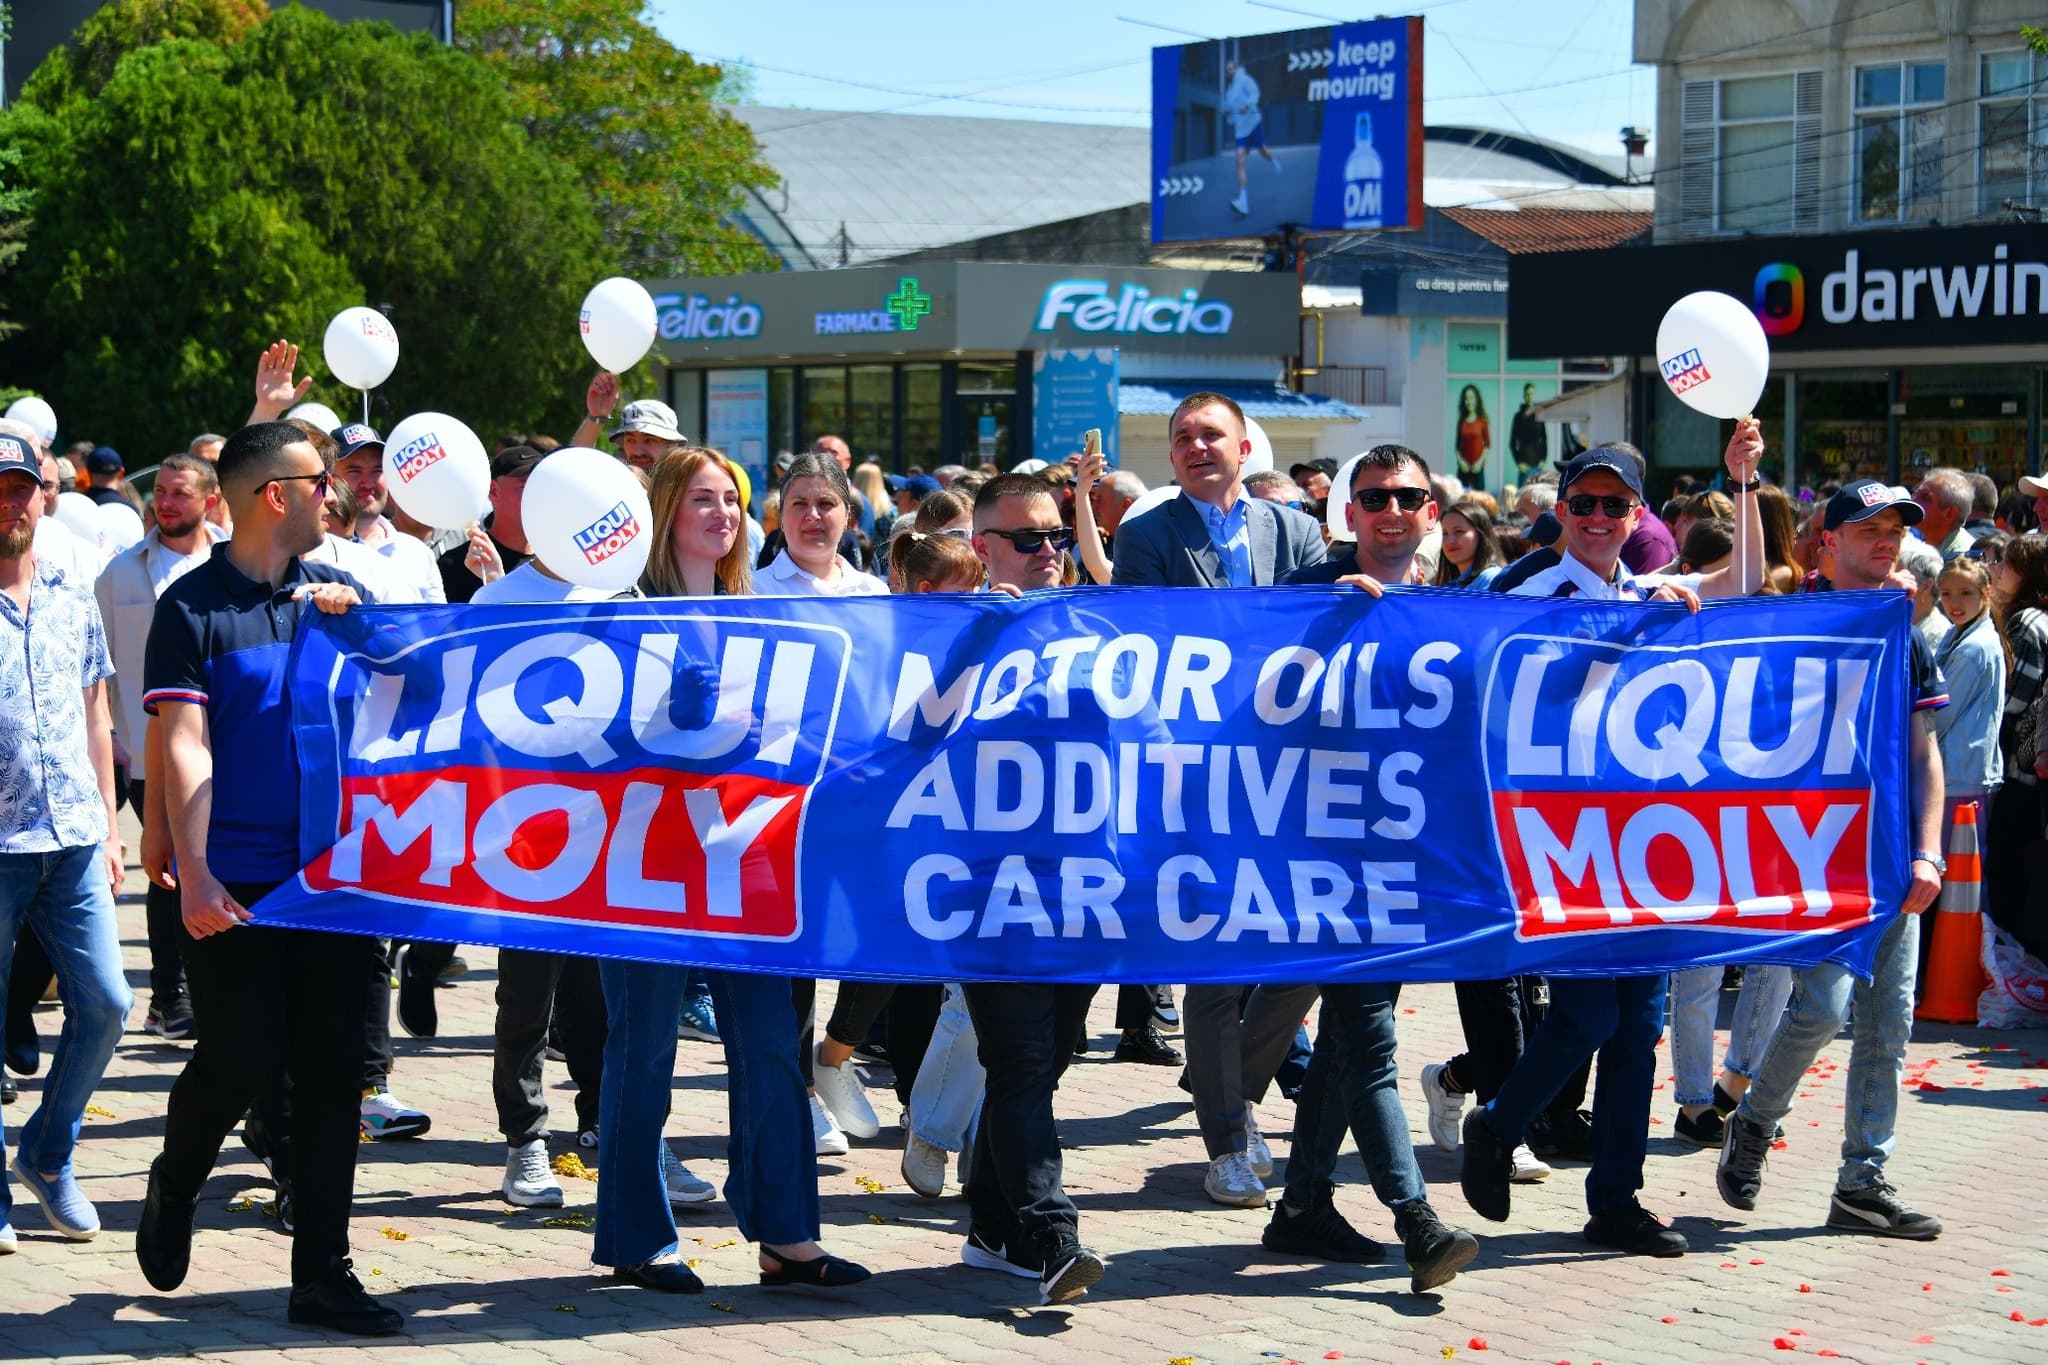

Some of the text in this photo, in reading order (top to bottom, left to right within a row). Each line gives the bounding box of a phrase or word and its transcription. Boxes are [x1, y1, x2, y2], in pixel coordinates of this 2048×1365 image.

[1337, 39, 1396, 69] keep
[1307, 67, 1396, 102] moving
[1038, 283, 1234, 334] Felicia
[1431, 277, 1456, 293] drag
[1457, 279, 1492, 294] pentru
[1821, 243, 2048, 325] darwin
[815, 311, 895, 335] FARMACIE
[394, 434, 438, 468] LIQUI
[401, 445, 443, 481] MOLY
[576, 503, 631, 549] LIQUI
[587, 518, 638, 563] MOLY
[348, 632, 817, 769] LIQUI
[886, 633, 1463, 742] MOTOR OILS
[1506, 652, 1871, 787] LIQUI
[885, 740, 1427, 841] ADDITIVES
[328, 778, 797, 918] MOLY
[1512, 803, 1863, 925] MOLY
[903, 853, 1427, 945] CAR CARE
